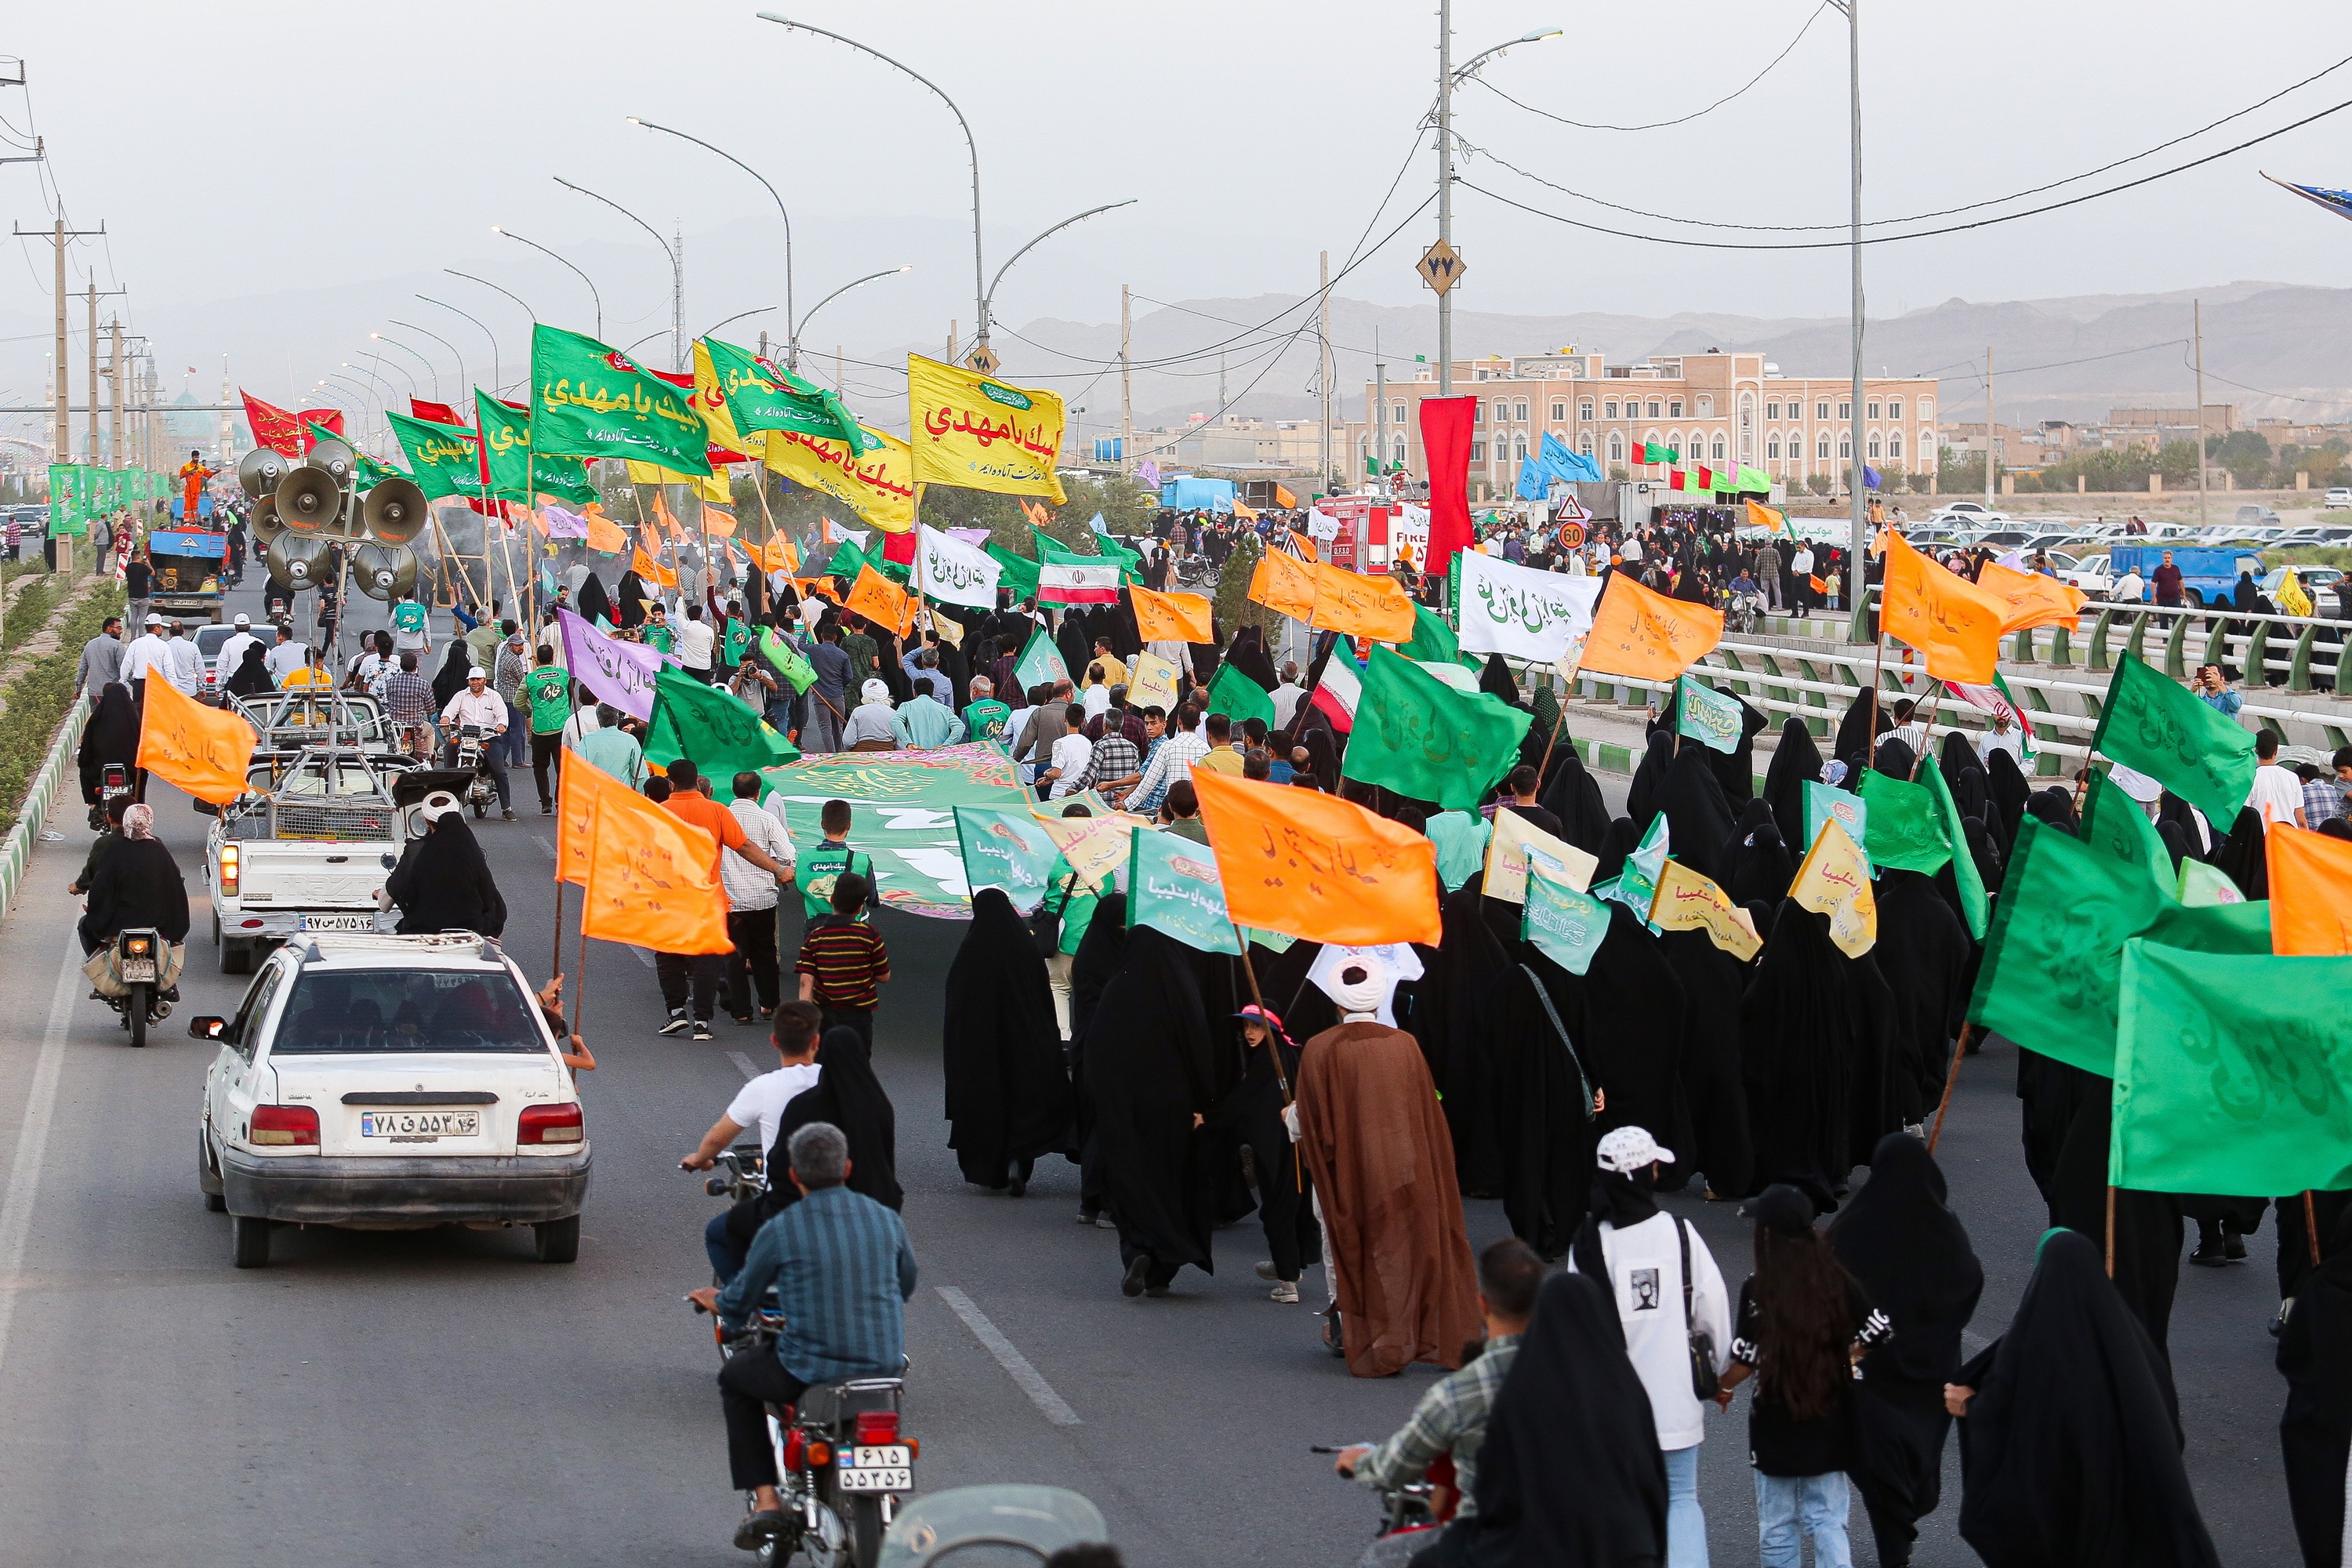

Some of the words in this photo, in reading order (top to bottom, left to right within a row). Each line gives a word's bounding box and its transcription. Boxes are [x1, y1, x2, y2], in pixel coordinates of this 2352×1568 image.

[1428, 257, 1454, 277] ۷۷
[925, 407, 1010, 447] مهدي
[1563, 529, 1581, 543] 60
[544, 684, 561, 701] خادم
[985, 720, 1004, 739] خادم
[862, 1448, 899, 1465] ۶۱۵
